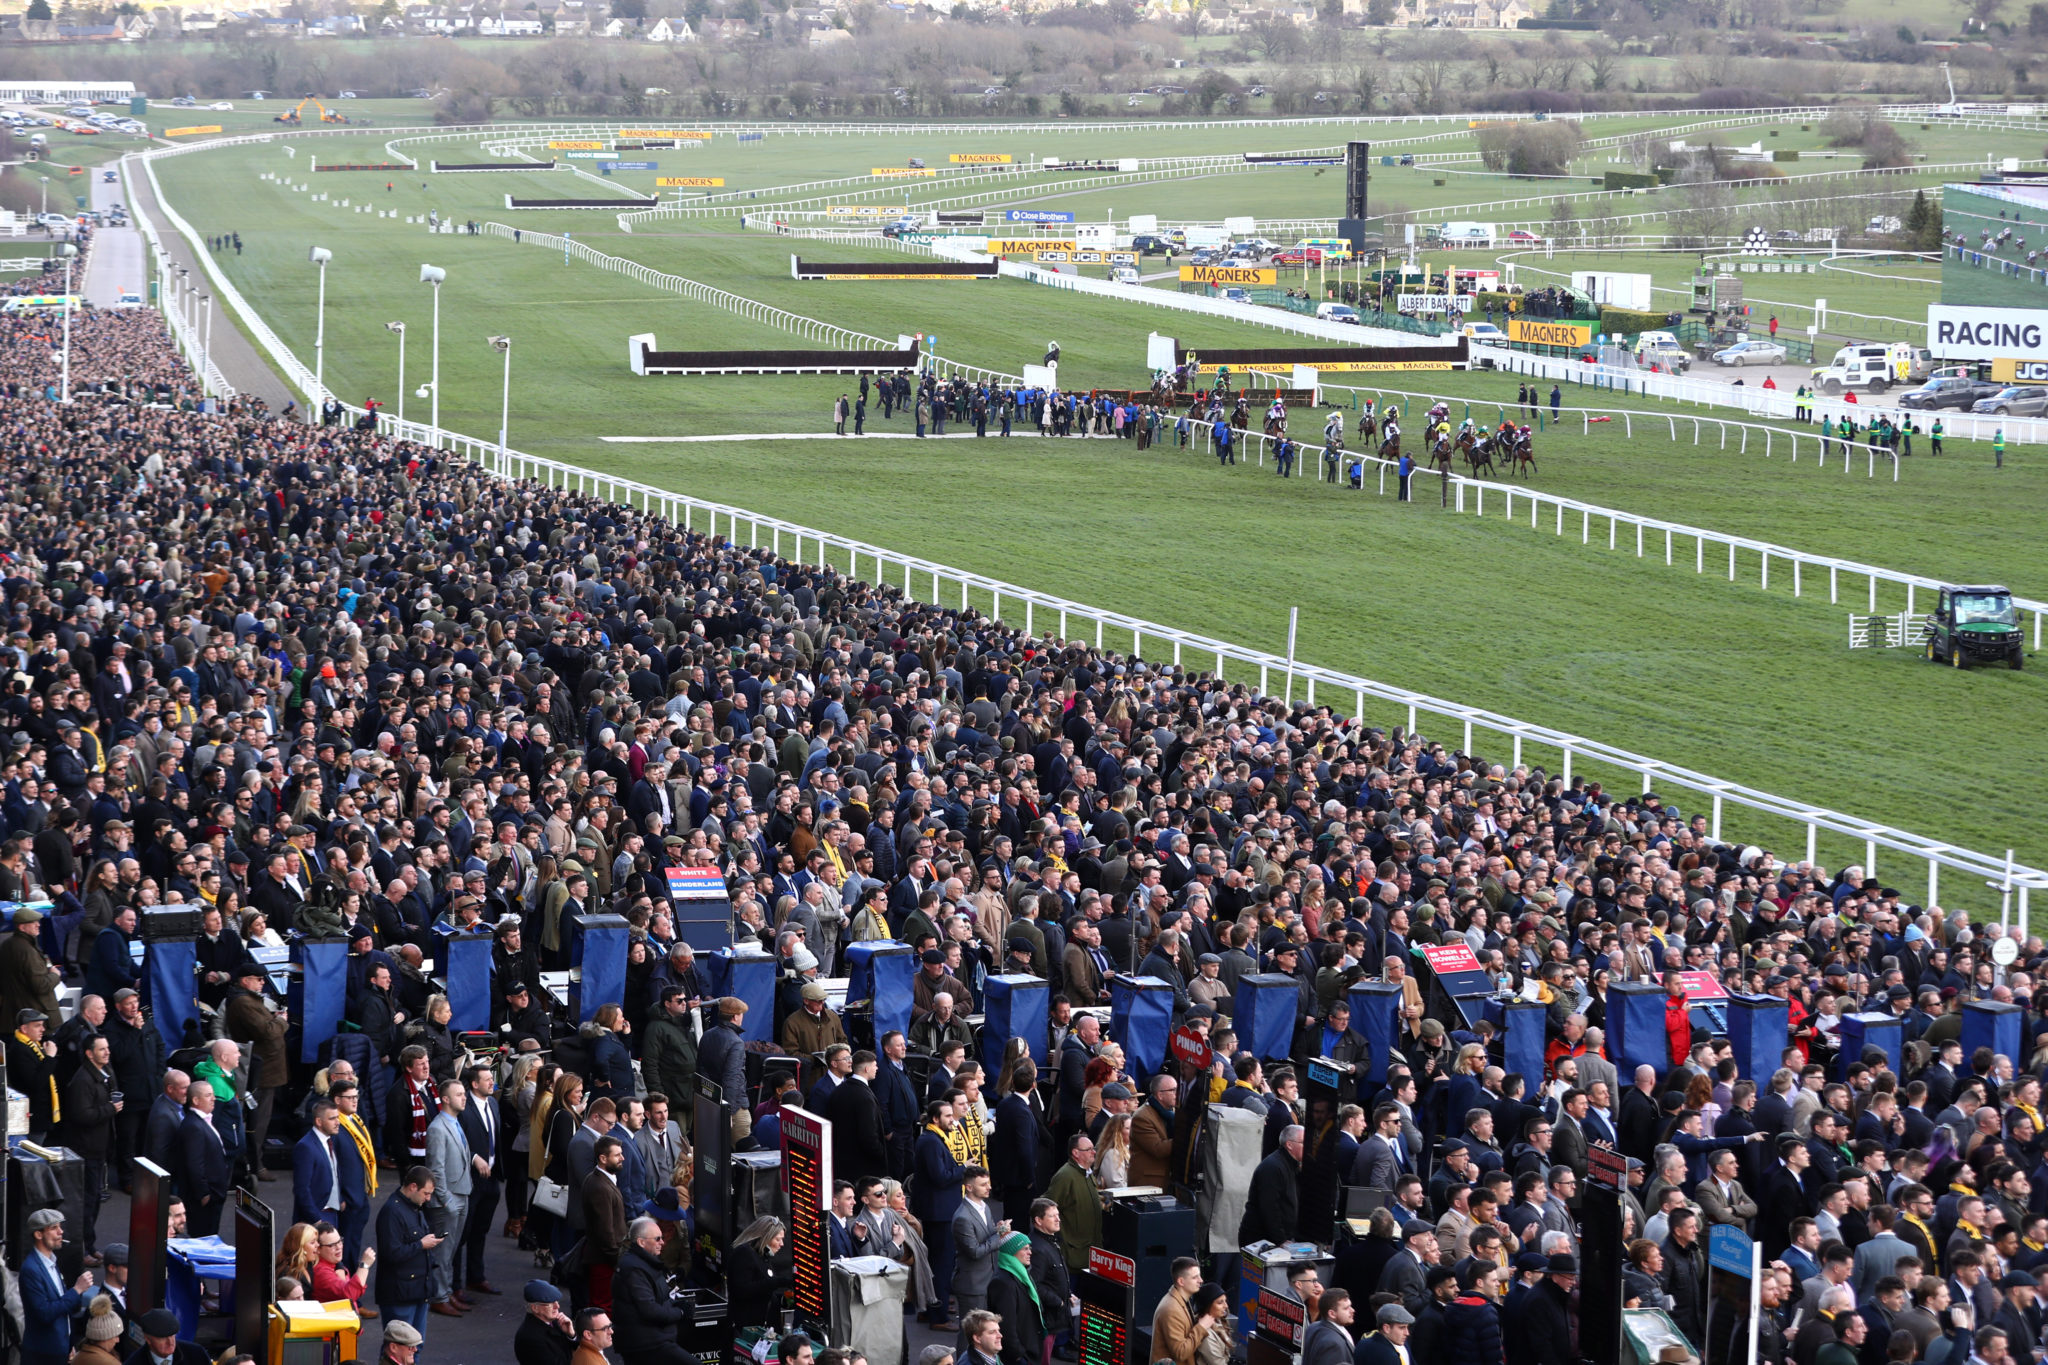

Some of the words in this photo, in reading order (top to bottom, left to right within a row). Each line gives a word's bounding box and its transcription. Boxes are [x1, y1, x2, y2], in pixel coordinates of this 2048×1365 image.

[625, 129, 658, 138] MAGNERS
[671, 131, 705, 139] MAGNERS
[556, 141, 593, 149] MAGNERS
[958, 154, 1002, 162] MAGNERS
[666, 178, 713, 187] MAGNERS
[830, 207, 853, 215] JCB
[856, 207, 879, 216] JCB
[881, 207, 904, 216] JCB
[1020, 211, 1038, 220] Close
[1039, 212, 1068, 222] Brothers
[1038, 250, 1067, 261] JCB
[1072, 251, 1101, 262] JCB
[1193, 265, 1260, 283] MAGNERS
[1400, 297, 1429, 310] ALBERT
[1520, 322, 1577, 346] MAGNERS
[1938, 320, 2042, 349] RACING
[2015, 363, 2048, 380] JC
[1431, 954, 1473, 963] HOWELLS
[1176, 1034, 1203, 1056] PINNO
[782, 1120, 820, 1149] GARRITTY
[1091, 1249, 1114, 1271] Barry
[1114, 1259, 1133, 1278] King
